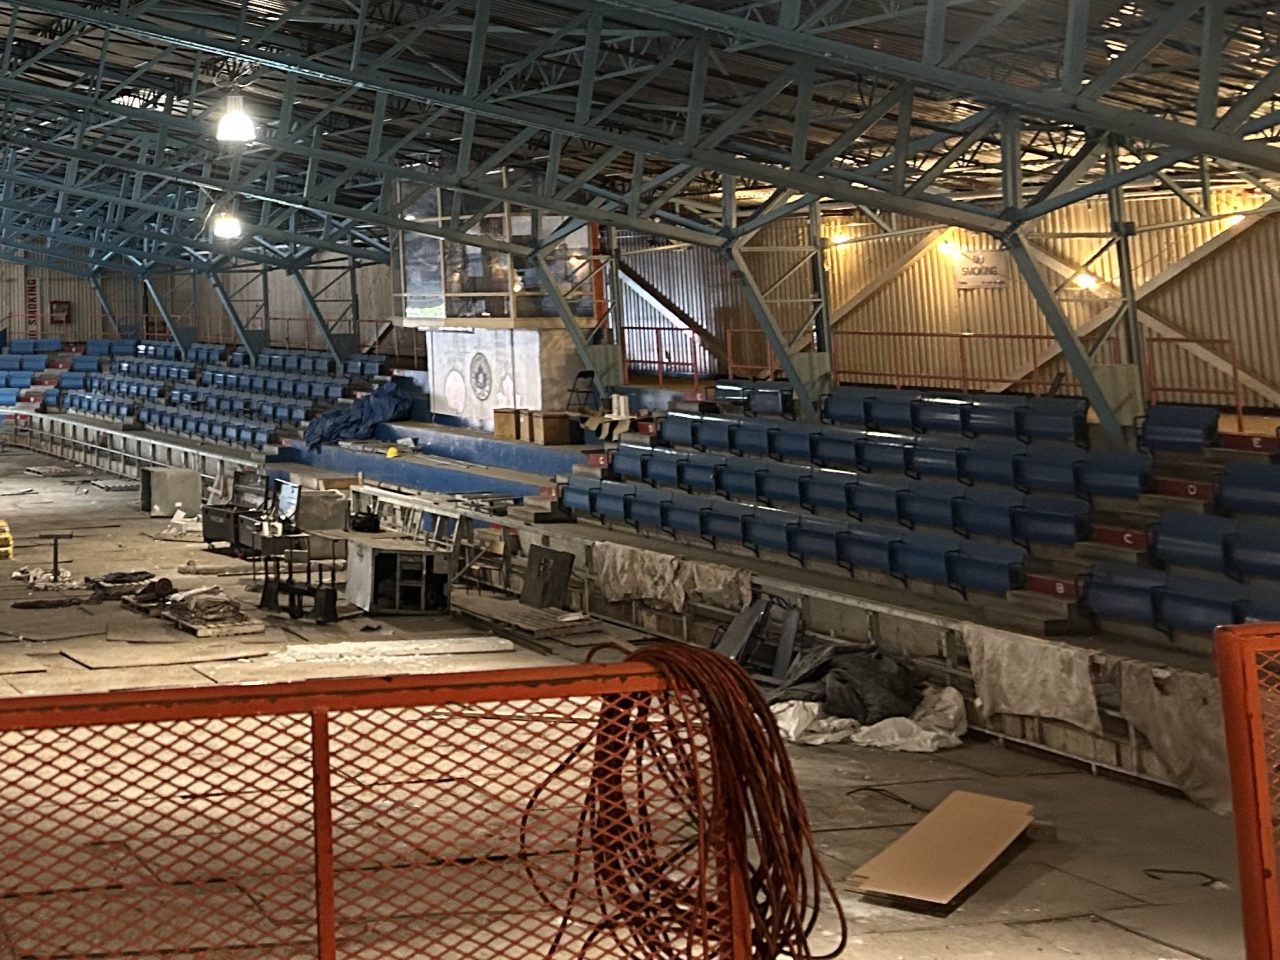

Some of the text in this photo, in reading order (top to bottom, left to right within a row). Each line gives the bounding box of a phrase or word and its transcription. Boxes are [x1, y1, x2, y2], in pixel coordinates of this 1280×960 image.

[962, 266, 998, 276] SMOKING
[27, 279, 38, 326] SMOKING
[1252, 437, 1262, 448] E
[1123, 533, 1133, 544] C
[1055, 581, 1065, 594] B
